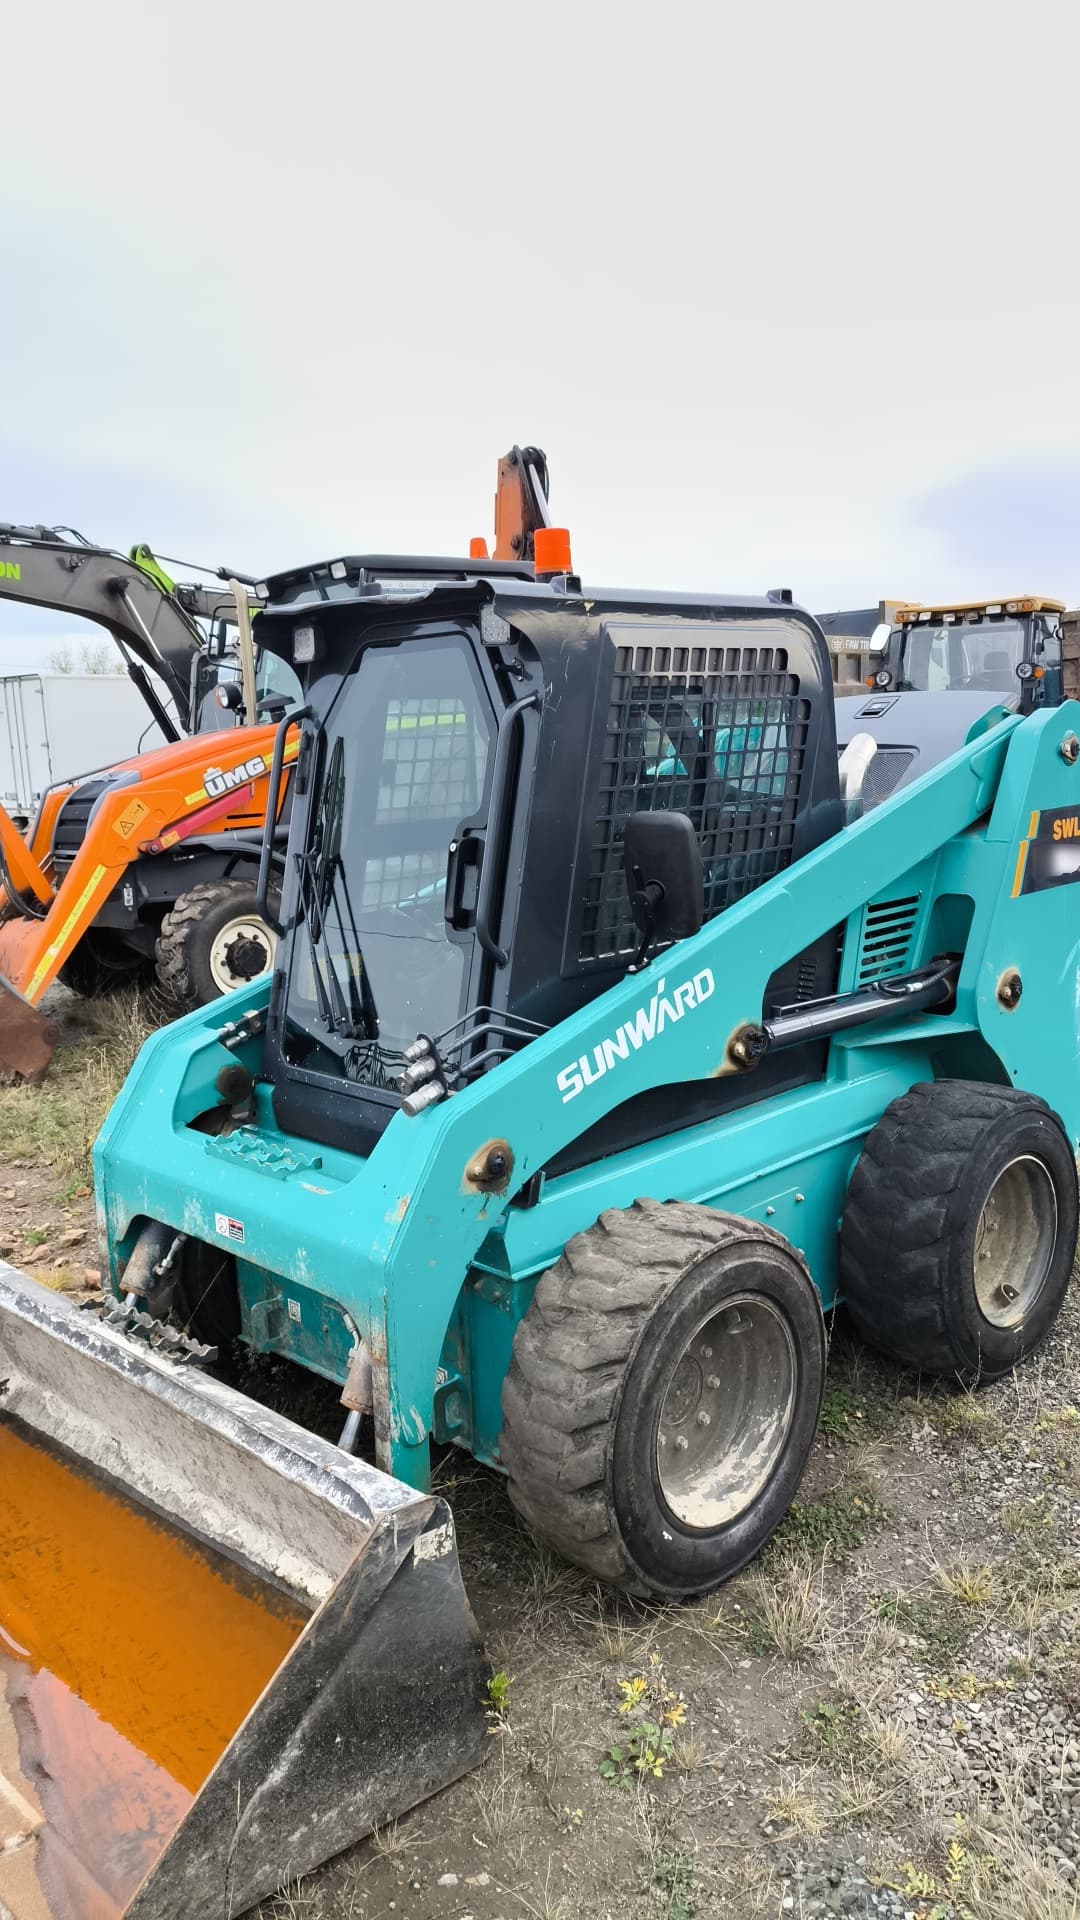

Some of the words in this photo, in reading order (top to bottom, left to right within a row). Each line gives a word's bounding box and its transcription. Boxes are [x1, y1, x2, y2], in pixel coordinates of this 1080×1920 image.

[845, 639, 860, 650] FAW
[204, 757, 266, 797] UMG
[1053, 817, 1080, 841] SWL
[556, 968, 715, 1104] SUNWARD
